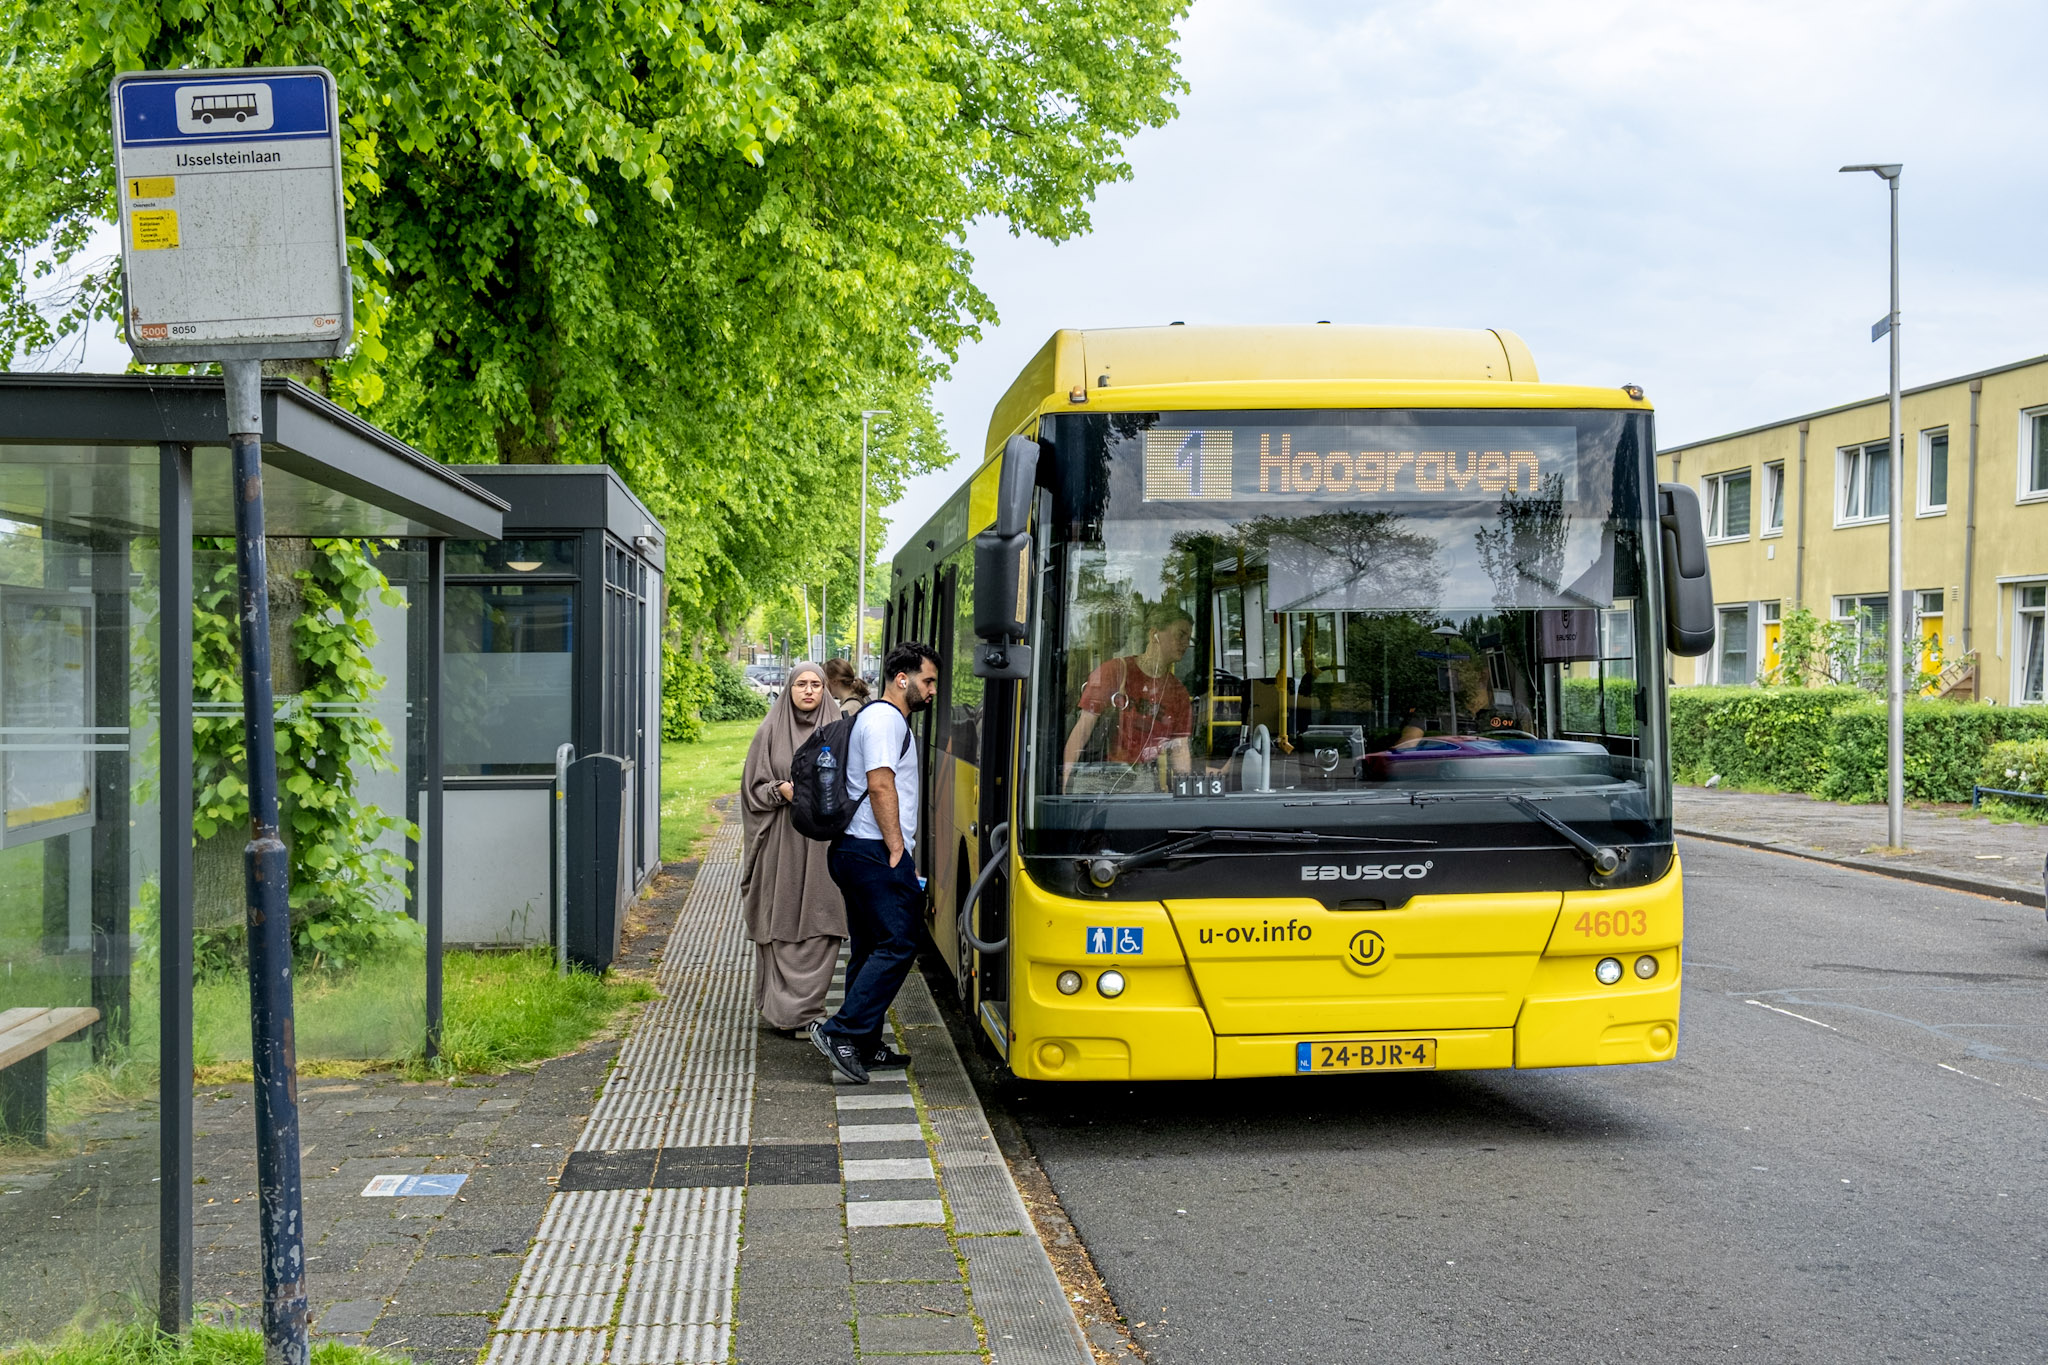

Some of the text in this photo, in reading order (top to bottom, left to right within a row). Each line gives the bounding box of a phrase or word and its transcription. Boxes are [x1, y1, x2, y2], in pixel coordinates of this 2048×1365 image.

[176, 150, 281, 167] IJsselsteinlaan
[133, 181, 140, 196] 1
[142, 325, 197, 336] 5000 8050
[1175, 430, 1540, 496] 1 Hoograven
[1199, 918, 1312, 944] u-ov.info
[1574, 909, 1647, 938] 4603
[1321, 1044, 1427, 1067] 24-BJR-4
